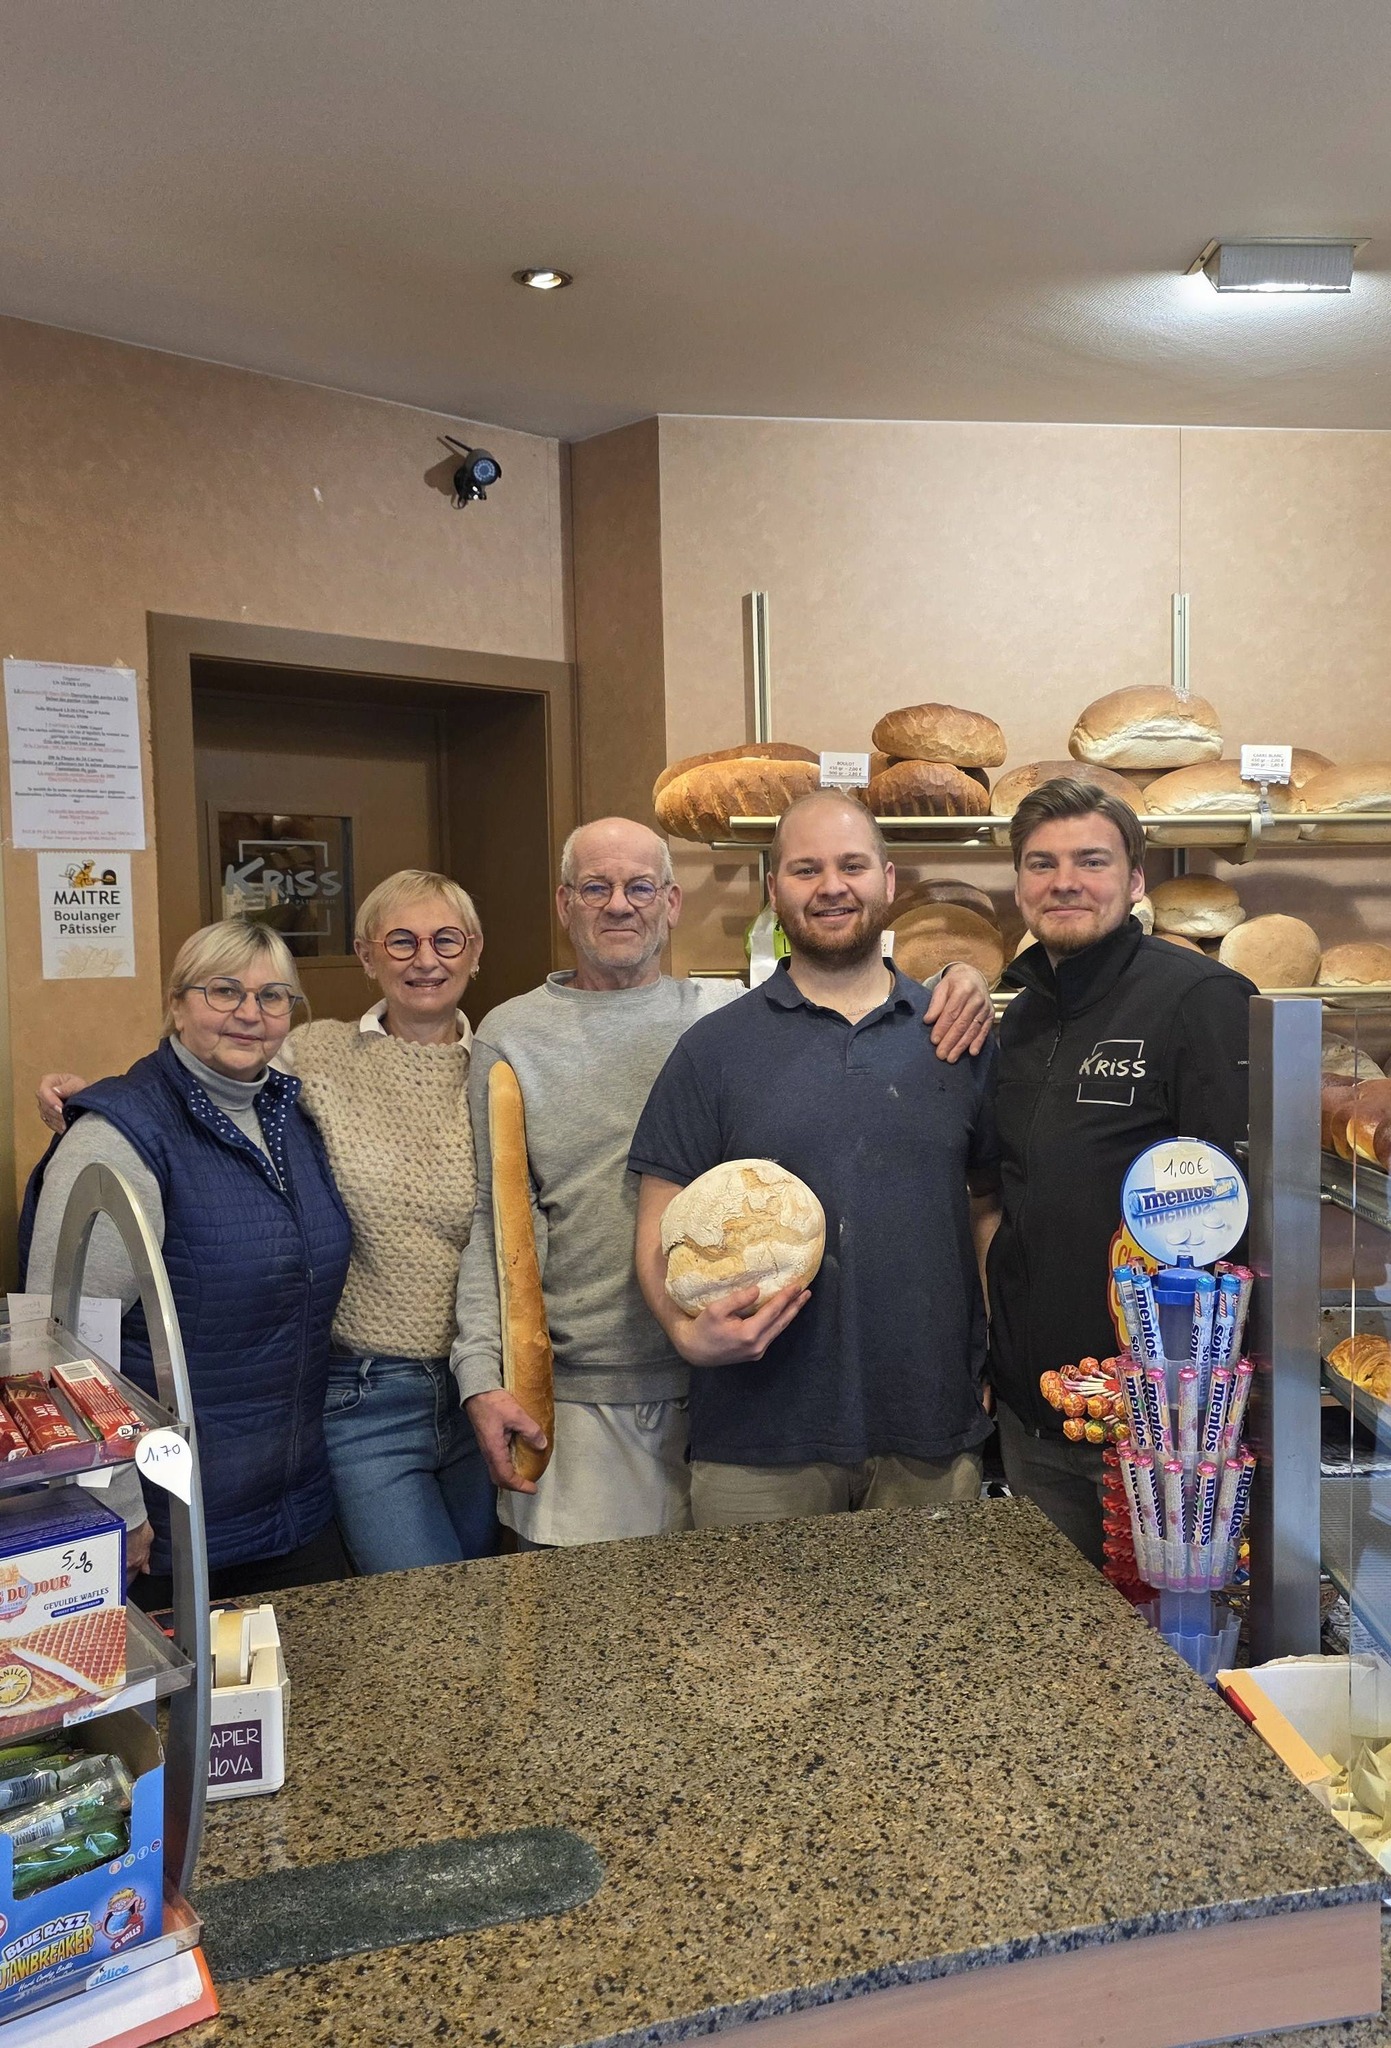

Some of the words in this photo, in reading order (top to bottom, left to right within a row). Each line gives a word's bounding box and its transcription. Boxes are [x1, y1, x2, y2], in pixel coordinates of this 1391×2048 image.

[53, 891, 121, 905] MAITRE
[54, 910, 121, 923] Boulanger
[60, 923, 117, 935] Pâtissier
[1142, 1187, 1213, 1211] mentos
[1136, 1289, 1158, 1360] mentos
[1126, 1376, 1147, 1448] mentos
[1147, 1382, 1163, 1451] mentos
[1205, 1381, 1226, 1452] mentos
[142, 1443, 181, 1464] 1,70
[1200, 1478, 1216, 1546] mentos
[1228, 1465, 1255, 1538] mentos
[7, 1586, 28, 1602] DU
[32, 1574, 71, 1597] JOUR
[43, 1595, 79, 1611] GEVULDE
[209, 1728, 260, 1750] APIER
[5, 1930, 42, 1960] BLUE
[44, 1913, 88, 1938] RAZZ
[0, 1923, 94, 1991] JAWBREAKER
